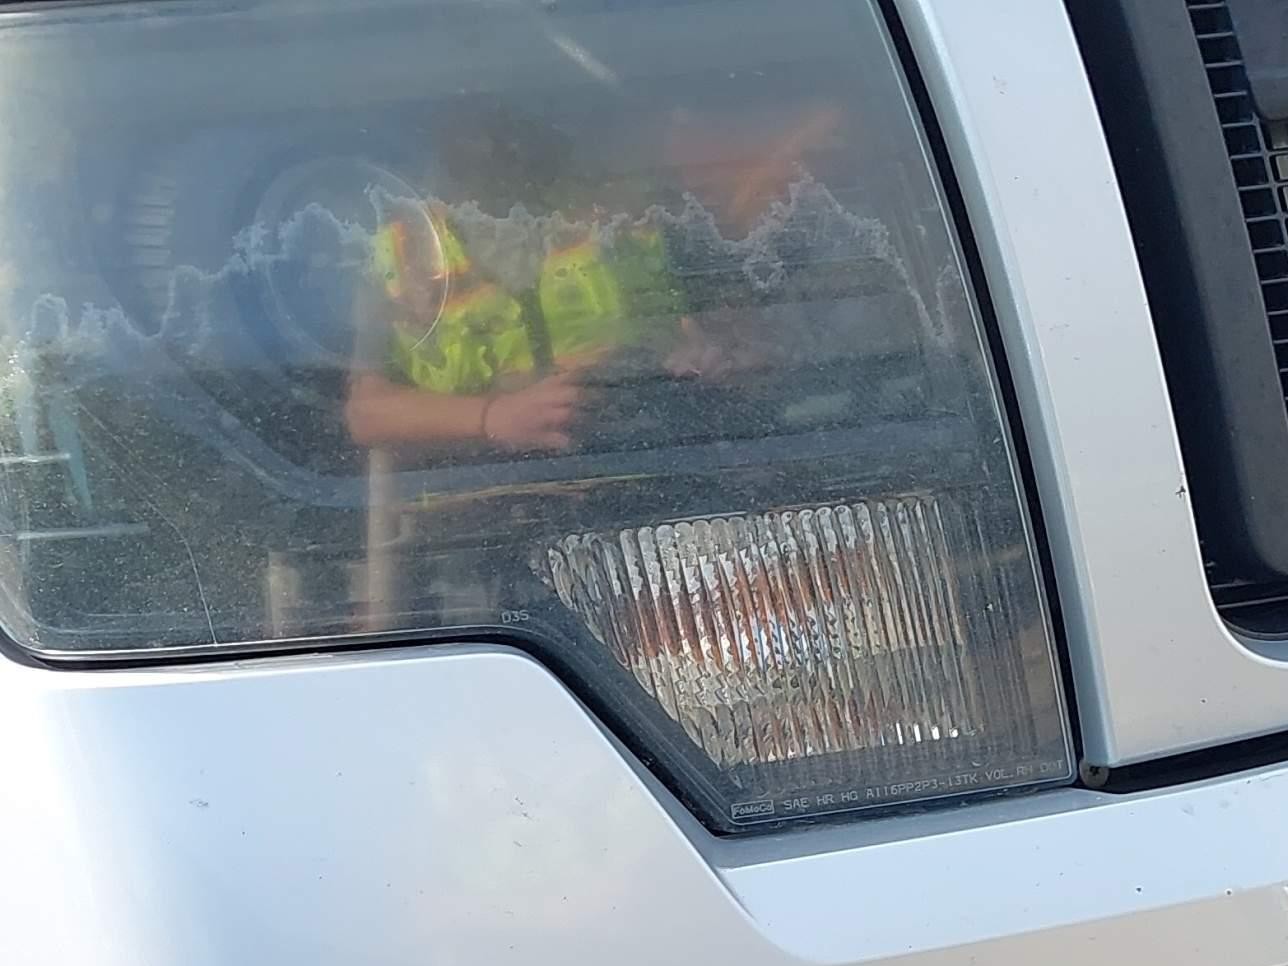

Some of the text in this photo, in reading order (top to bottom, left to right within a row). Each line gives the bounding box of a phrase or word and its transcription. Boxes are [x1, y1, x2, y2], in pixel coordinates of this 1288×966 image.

[501, 610, 529, 624] D3S
[734, 803, 772, 816] FoMoCo
[783, 797, 810, 811] SAE
[816, 794, 834, 806] HR
[841, 790, 858, 802] HG
